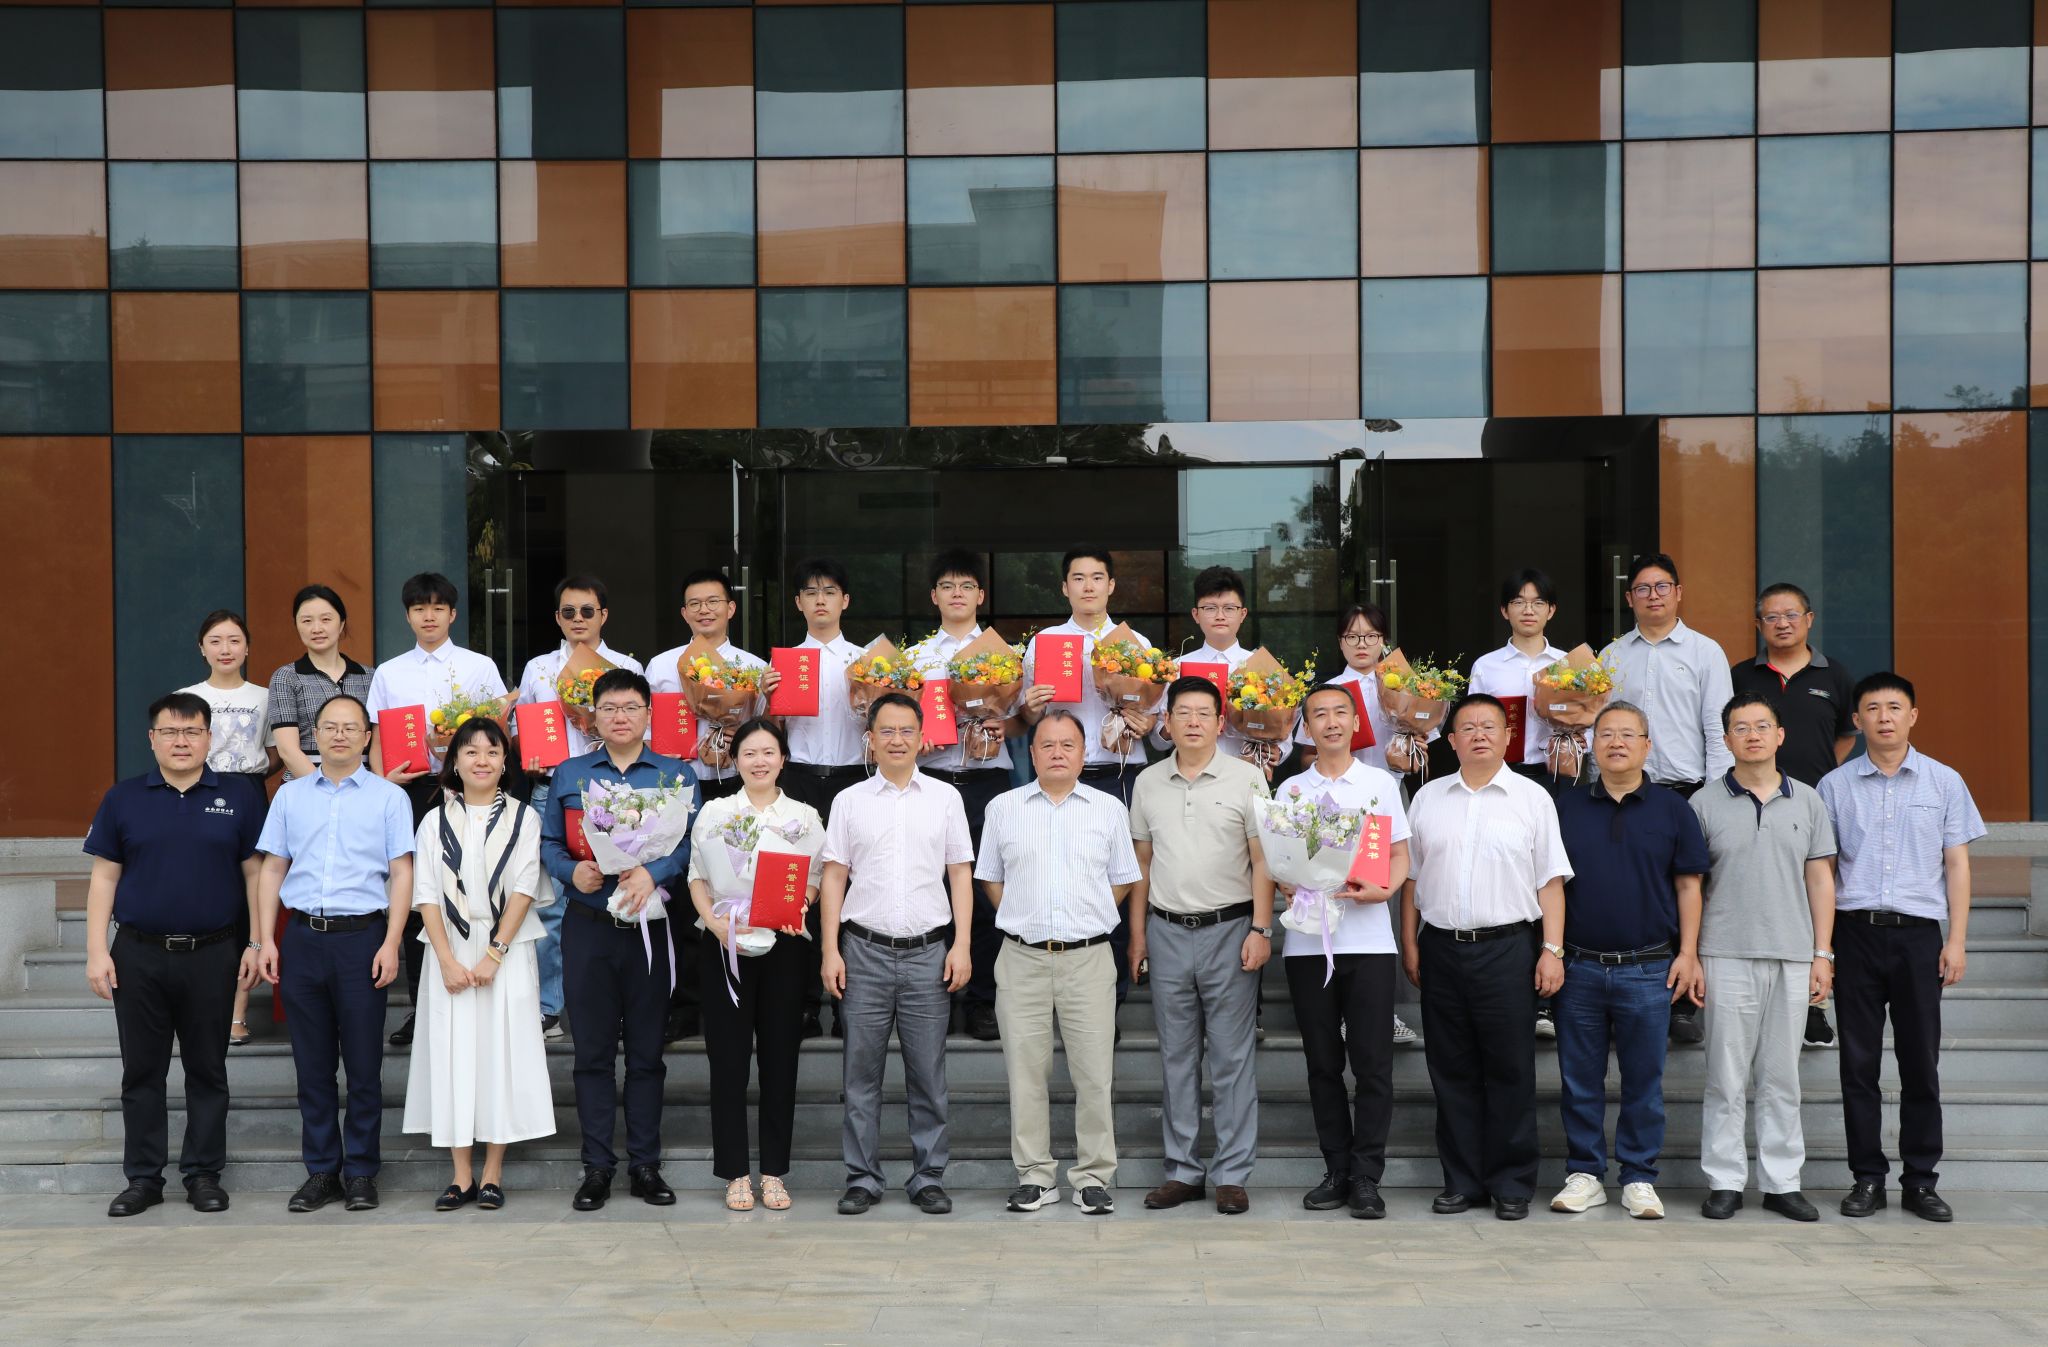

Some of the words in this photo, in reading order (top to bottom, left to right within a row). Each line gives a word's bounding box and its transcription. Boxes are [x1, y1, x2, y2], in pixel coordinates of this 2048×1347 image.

[798, 655, 810, 692] 荣誉证书
[1061, 641, 1074, 678] 荣誉证书
[1207, 671, 1219, 685] 荣
[210, 702, 260, 714] eekend
[677, 699, 689, 735] 荣誉证书
[933, 686, 947, 721] 荣誉证书
[1508, 703, 1519, 738] 荣誉证书
[404, 713, 418, 748] 荣誉证书
[543, 708, 558, 742] 荣誉证书
[1367, 822, 1380, 860] 荣誉证书
[784, 862, 799, 904] 荣誉证书
